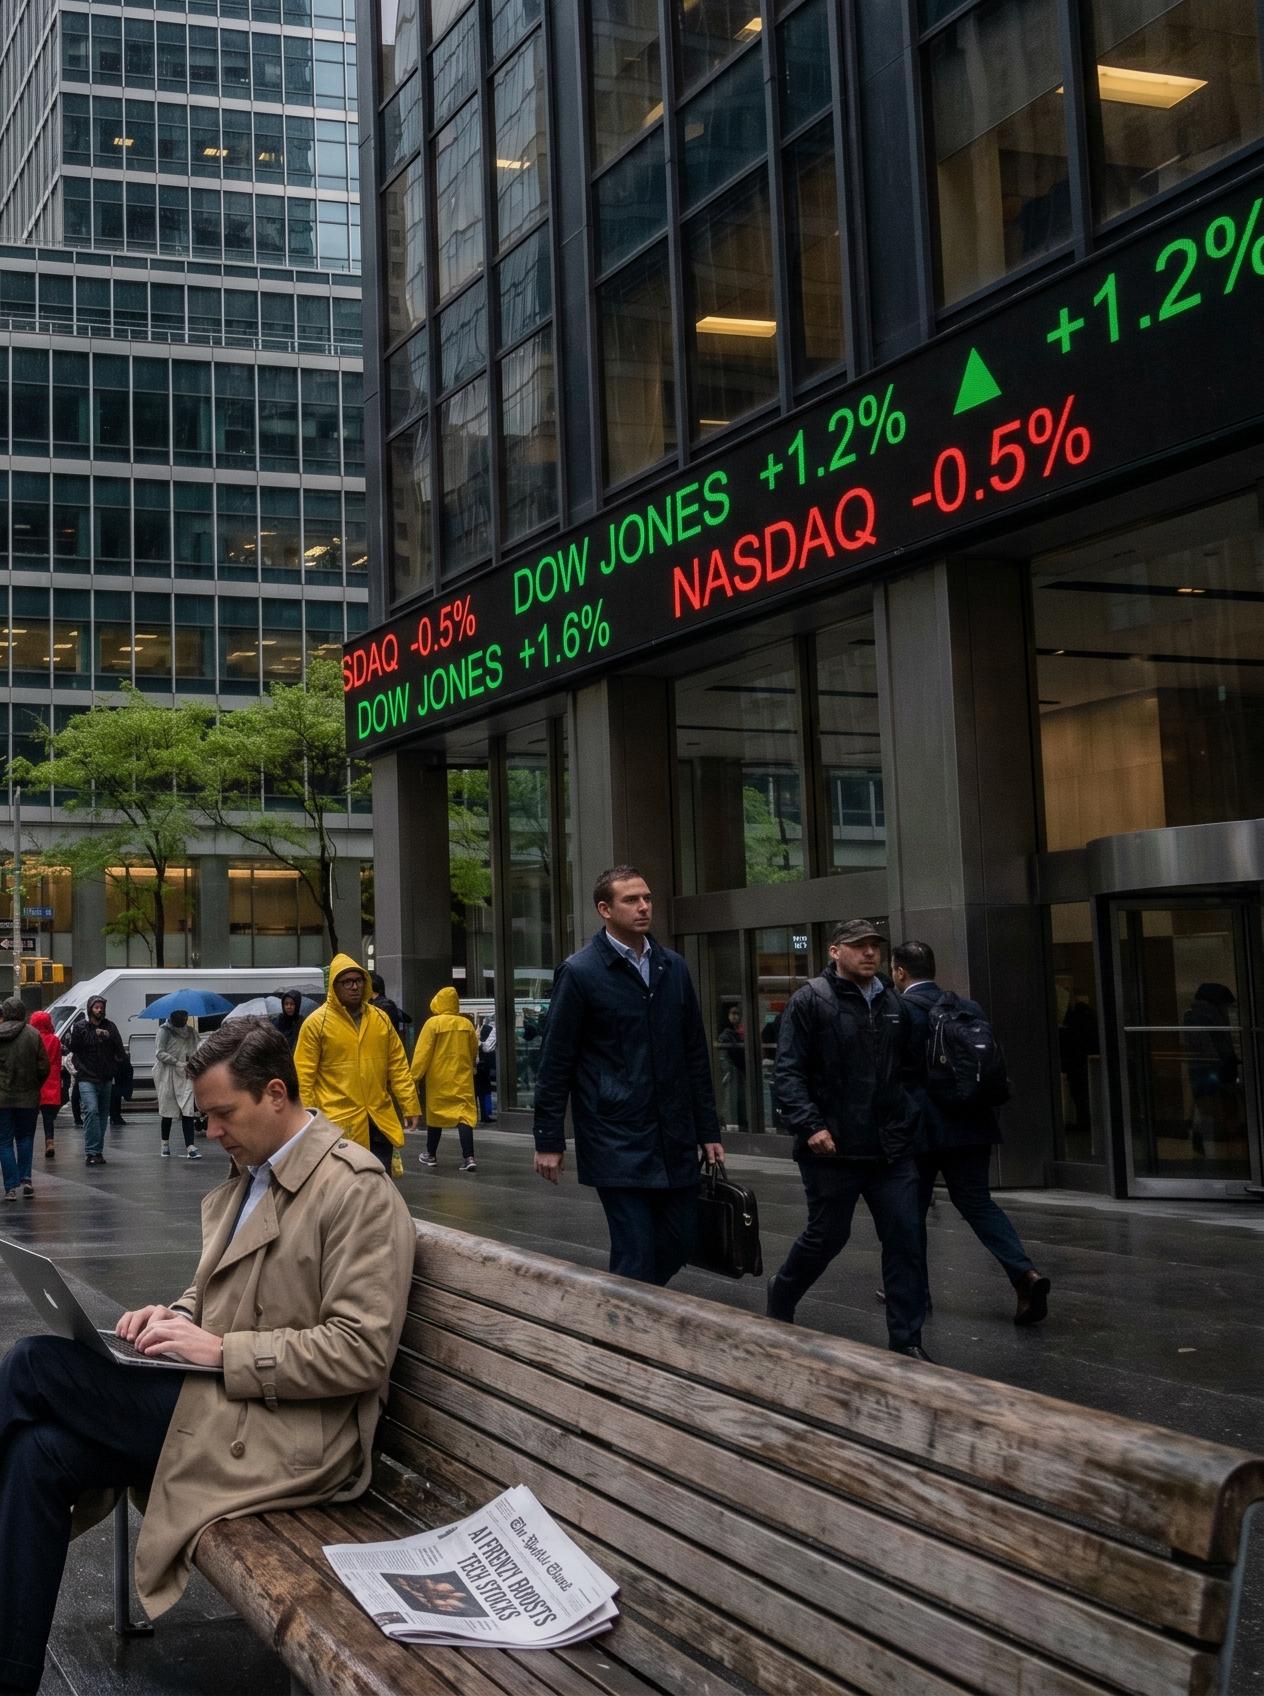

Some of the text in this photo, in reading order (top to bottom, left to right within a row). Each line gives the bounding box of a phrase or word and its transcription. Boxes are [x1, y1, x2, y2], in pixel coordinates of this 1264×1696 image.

[513, 197, 1264, 616] DOW JONES +1.2% +1.2%
[673, 394, 1091, 618] NASDAQ -0.5%
[357, 598, 610, 740] DOW JONES +1.6%
[410, 594, 476, 657] -0.5%
[457, 1552, 521, 1621] TECH STOCKS
[468, 1526, 493, 1549] AI
[481, 1536, 523, 1582] FRENZY
[508, 1577, 557, 1627] BOOSTS
